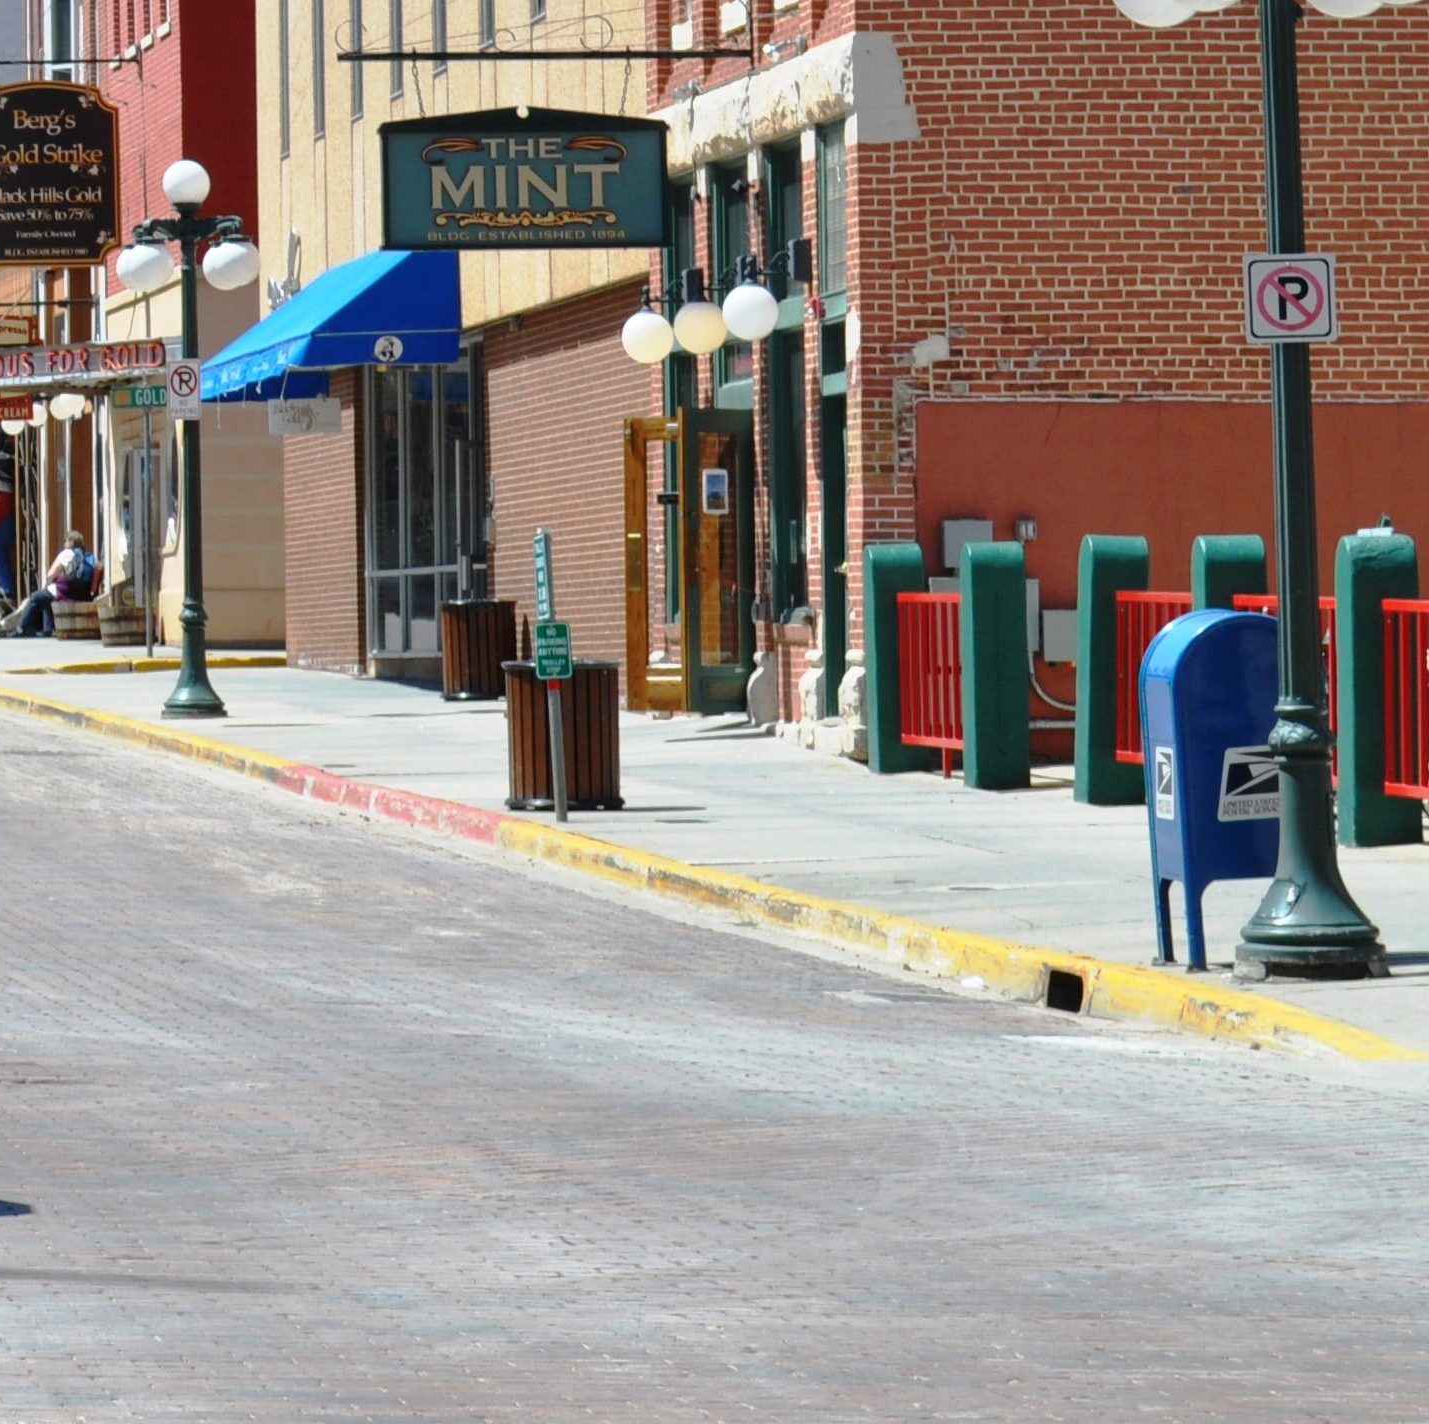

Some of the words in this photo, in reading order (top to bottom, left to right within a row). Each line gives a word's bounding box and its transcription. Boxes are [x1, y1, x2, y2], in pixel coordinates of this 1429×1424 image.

[13, 109, 77, 136] Berg's
[43, 143, 103, 164] Strike
[480, 137, 563, 160] THE
[430, 162, 620, 209] MINT
[30, 187, 64, 204] Hills
[65, 187, 102, 203] Gold
[27, 208, 52, 221] 50%
[54, 209, 67, 221] to
[68, 207, 94, 221] 75%
[16, 230, 43, 240] Family
[45, 230, 76, 238] Owned
[427, 231, 475, 241] BLDG.
[478, 229, 586, 241] ESTABLISHED
[591, 229, 626, 239] 1894
[46, 347, 90, 373] FOR
[99, 340, 166, 372] GOLD
[135, 389, 167, 406] GOLD
[537, 638, 567, 646] PARKING
[538, 647, 568, 656] ANYTIME
[1223, 799, 1253, 810] UNITED
[1223, 807, 1251, 817] POSTAL
